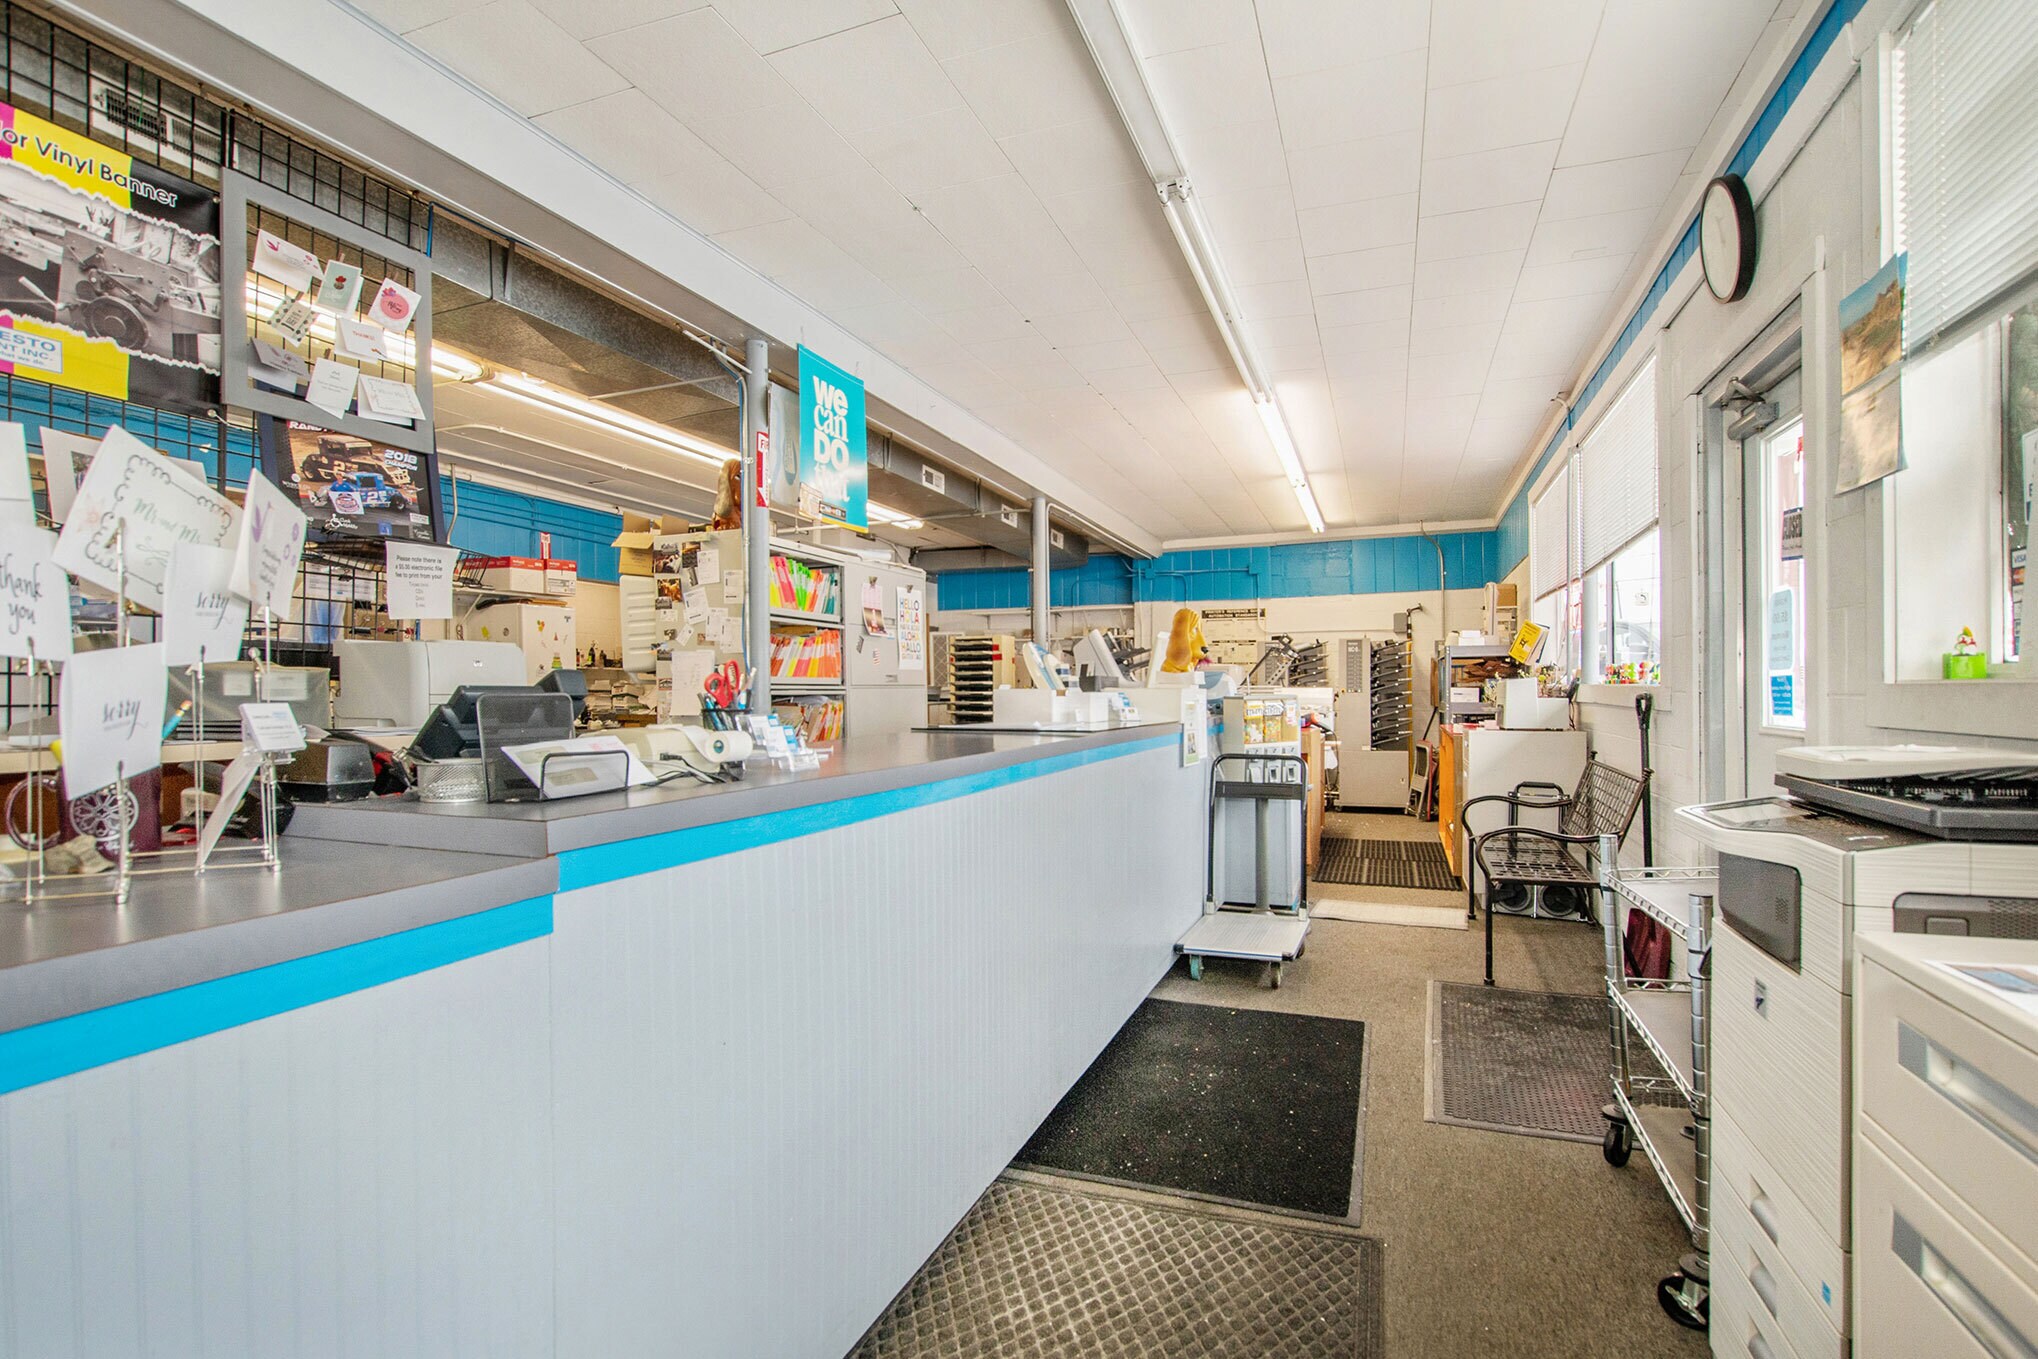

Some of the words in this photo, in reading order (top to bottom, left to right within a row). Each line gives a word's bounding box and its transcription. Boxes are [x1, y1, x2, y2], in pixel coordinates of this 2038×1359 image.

[35, 136, 94, 175] Vinyl
[100, 163, 178, 208] Banner
[22, 348, 53, 361] INC.
[814, 405, 849, 442] can
[384, 449, 418, 465] 2018
[384, 459, 418, 471] CHAMPION
[814, 428, 849, 471] DO
[814, 462, 850, 502] that
[8, 602, 36, 635] you
[900, 599, 920, 611] HELLO
[900, 609, 920, 623] HOLA
[102, 700, 141, 741] sorry
